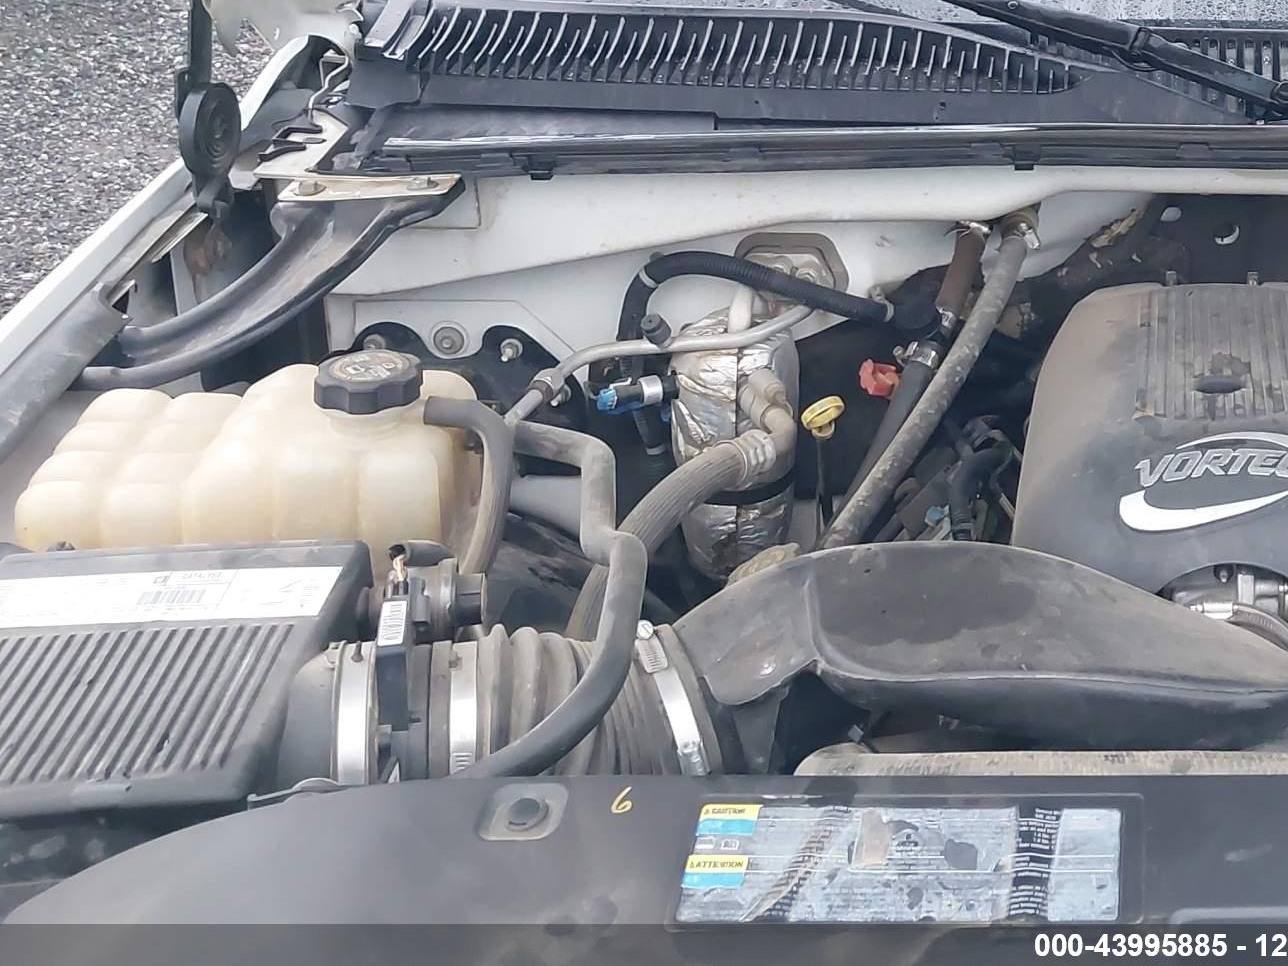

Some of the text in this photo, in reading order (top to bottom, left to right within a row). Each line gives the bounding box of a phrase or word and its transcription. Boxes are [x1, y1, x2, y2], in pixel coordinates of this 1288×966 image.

[611, 786, 633, 814] 6
[711, 807, 747, 815] CAUTION
[695, 860, 745, 869] ATTENTION
